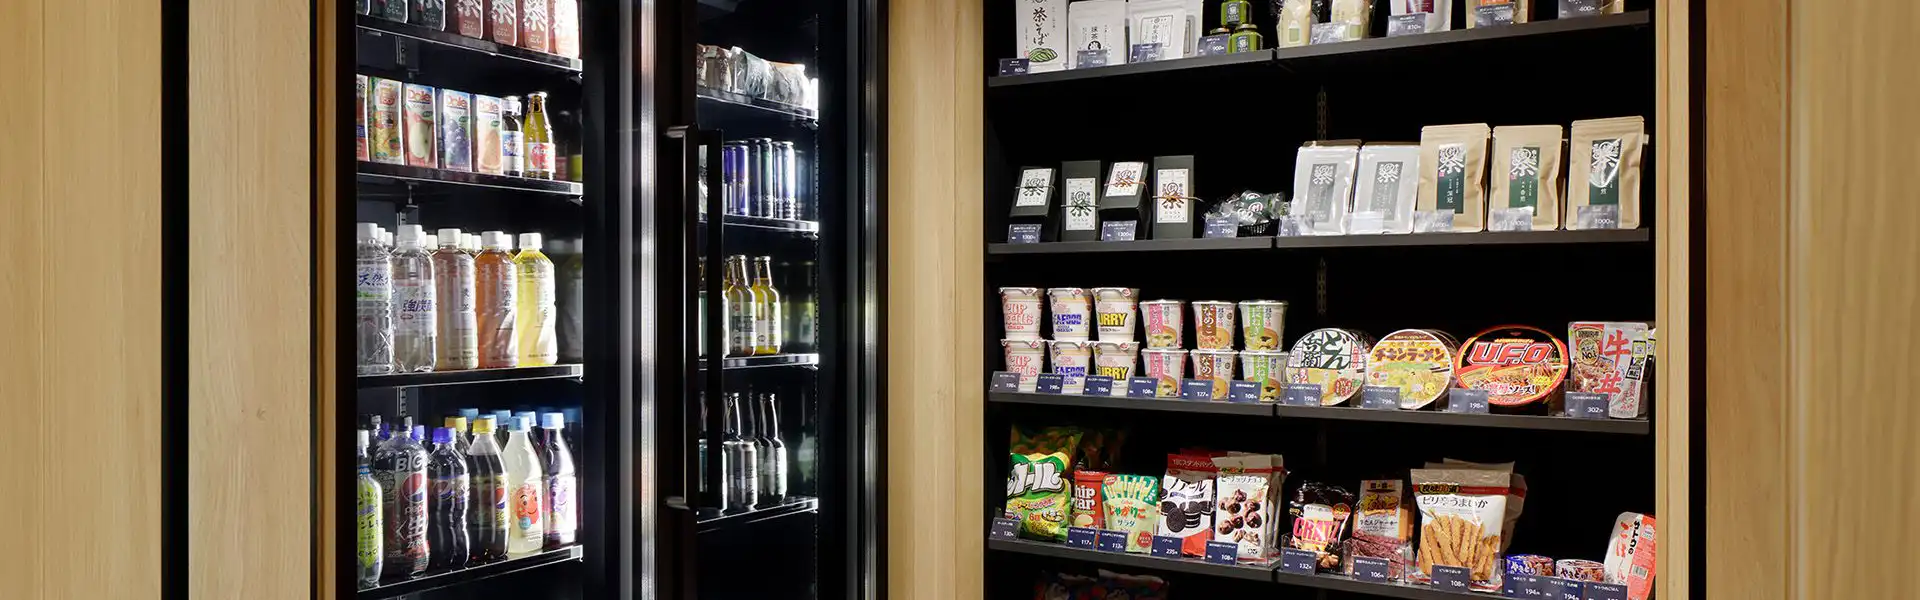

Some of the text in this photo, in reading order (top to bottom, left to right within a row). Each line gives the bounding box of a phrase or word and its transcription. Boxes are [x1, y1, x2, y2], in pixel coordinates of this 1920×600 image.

[1033, 7, 1049, 45] 茶そば
[408, 90, 432, 101] Dole
[448, 95, 467, 107] Dole
[1375, 347, 1444, 361] チキンラーメン
[396, 454, 423, 471] BIG
[1075, 485, 1095, 498] hip
[1075, 500, 1095, 510] tar
[1109, 506, 1145, 519] じゃがりこ
